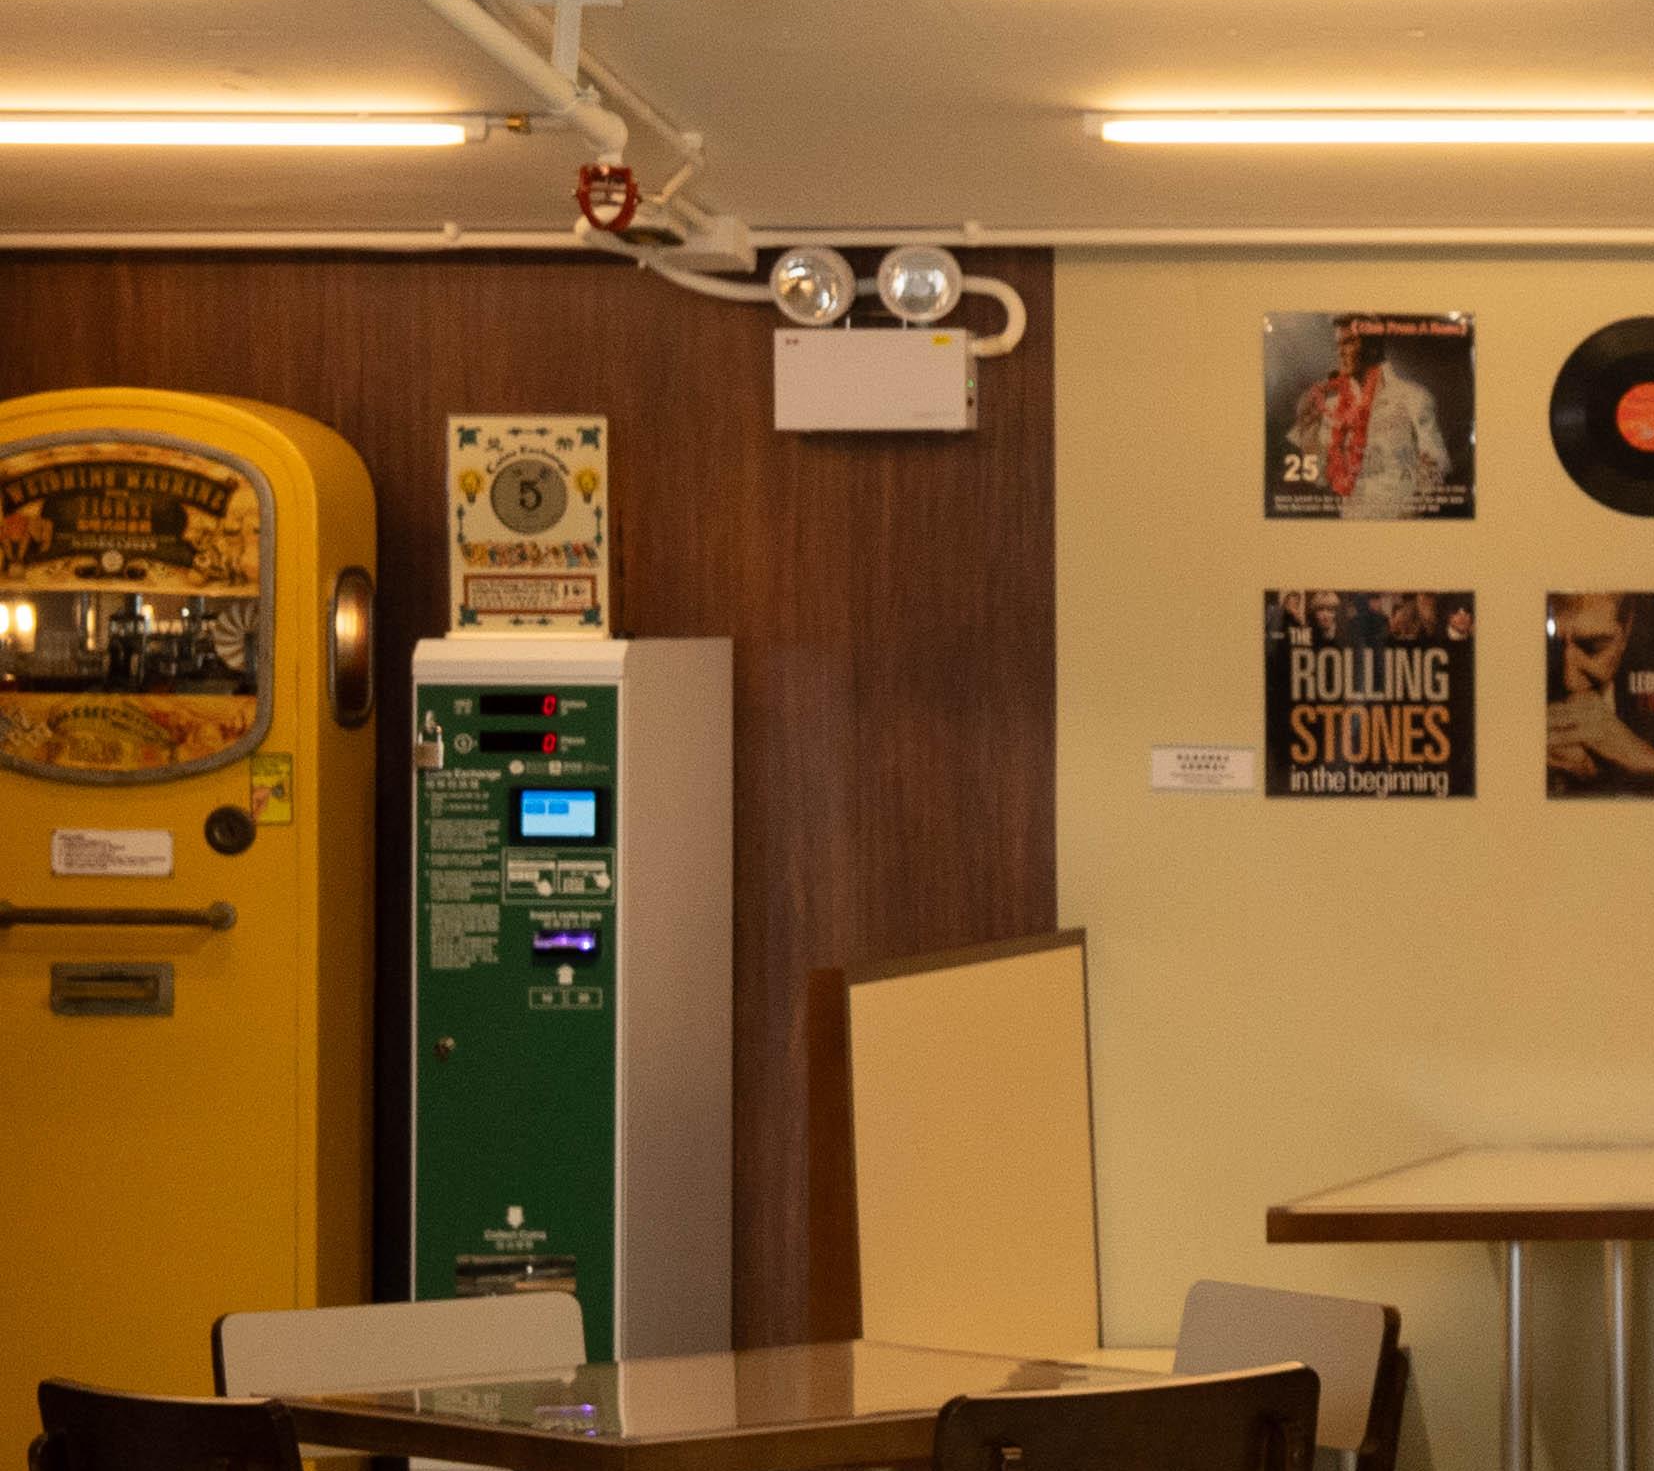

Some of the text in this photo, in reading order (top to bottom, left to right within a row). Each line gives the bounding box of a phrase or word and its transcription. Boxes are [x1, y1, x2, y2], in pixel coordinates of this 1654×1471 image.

[1284, 454, 1319, 482] 25
[519, 480, 543, 512] 5
[1289, 626, 1313, 645] THE
[1290, 647, 1450, 701] ROLLING
[1290, 705, 1451, 764] STONES
[1291, 766, 1449, 798] in the beginning
